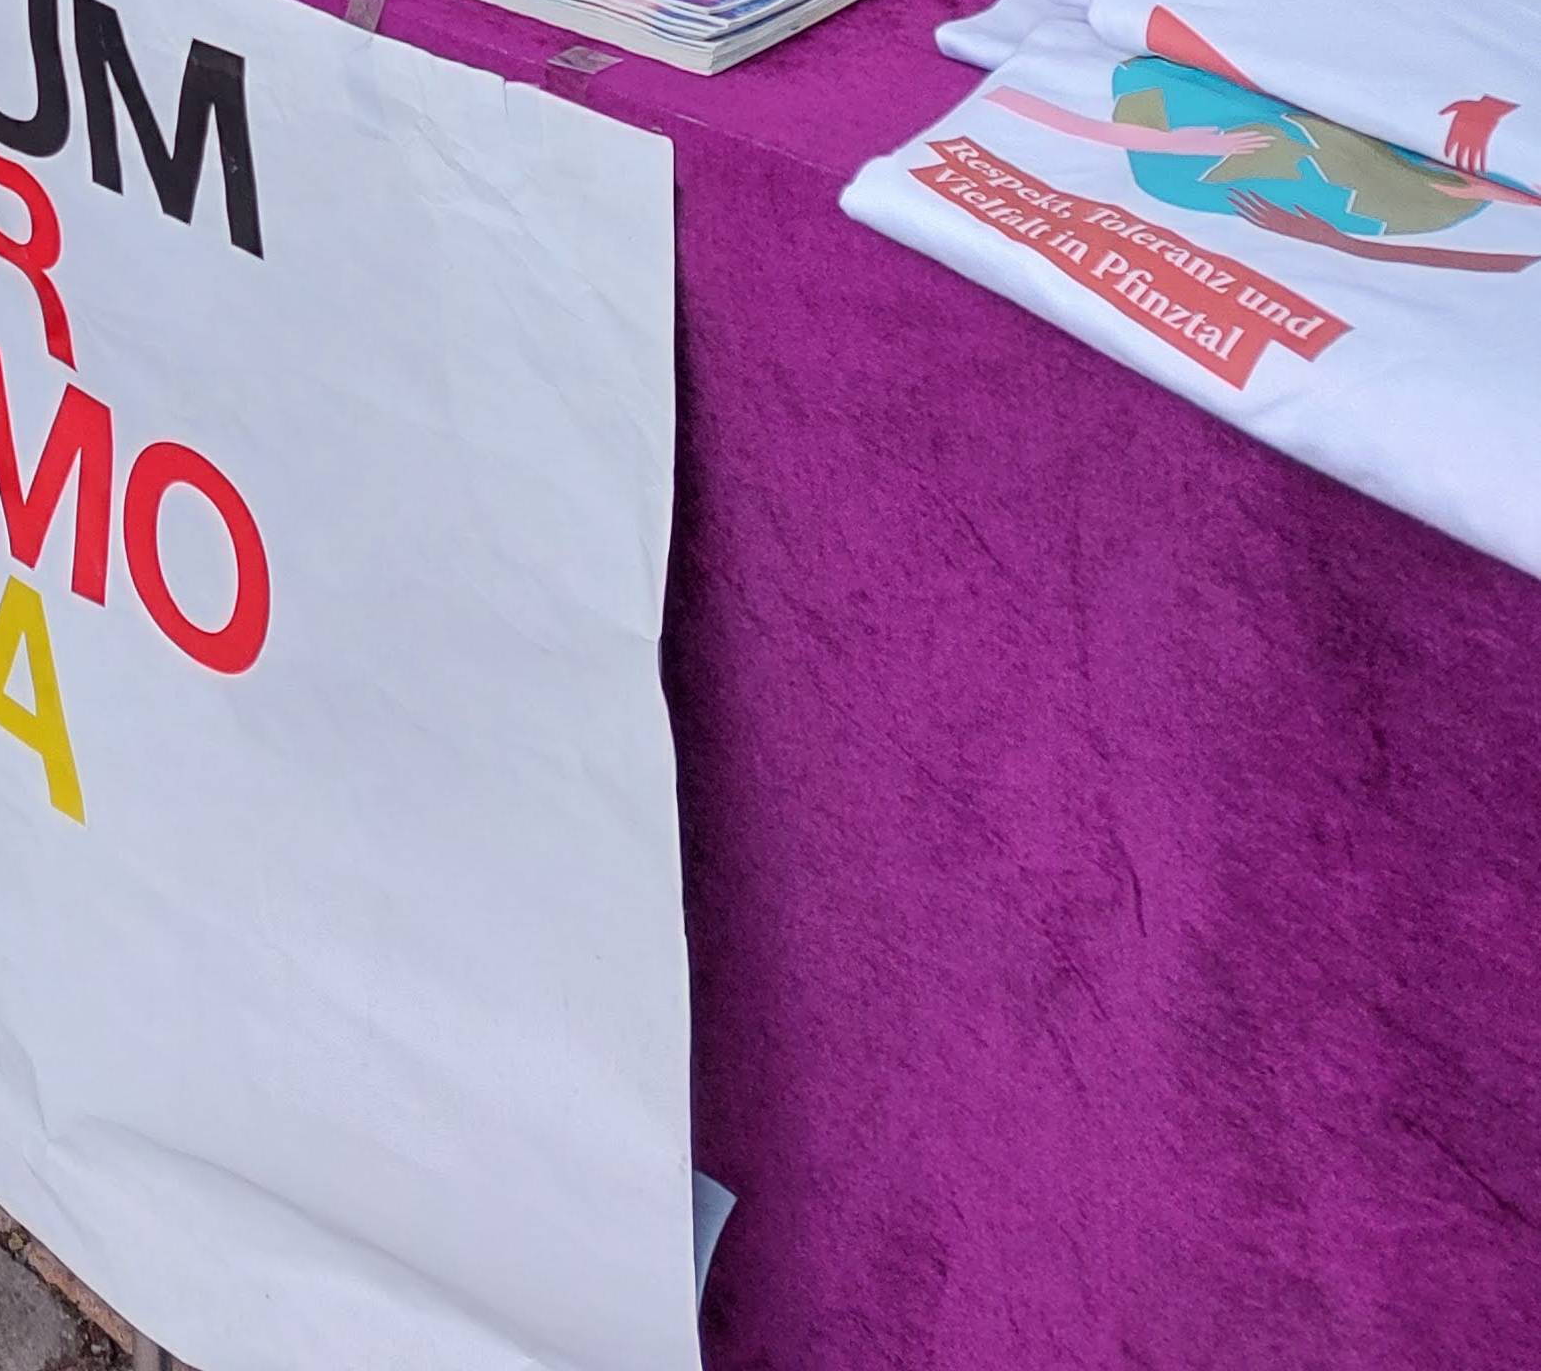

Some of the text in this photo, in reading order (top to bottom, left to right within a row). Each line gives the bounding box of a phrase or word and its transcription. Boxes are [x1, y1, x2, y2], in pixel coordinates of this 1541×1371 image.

[934, 169, 1245, 360] Vielfalt in Pfinztal
[944, 140, 1327, 340] Respekt, Toleranz und
